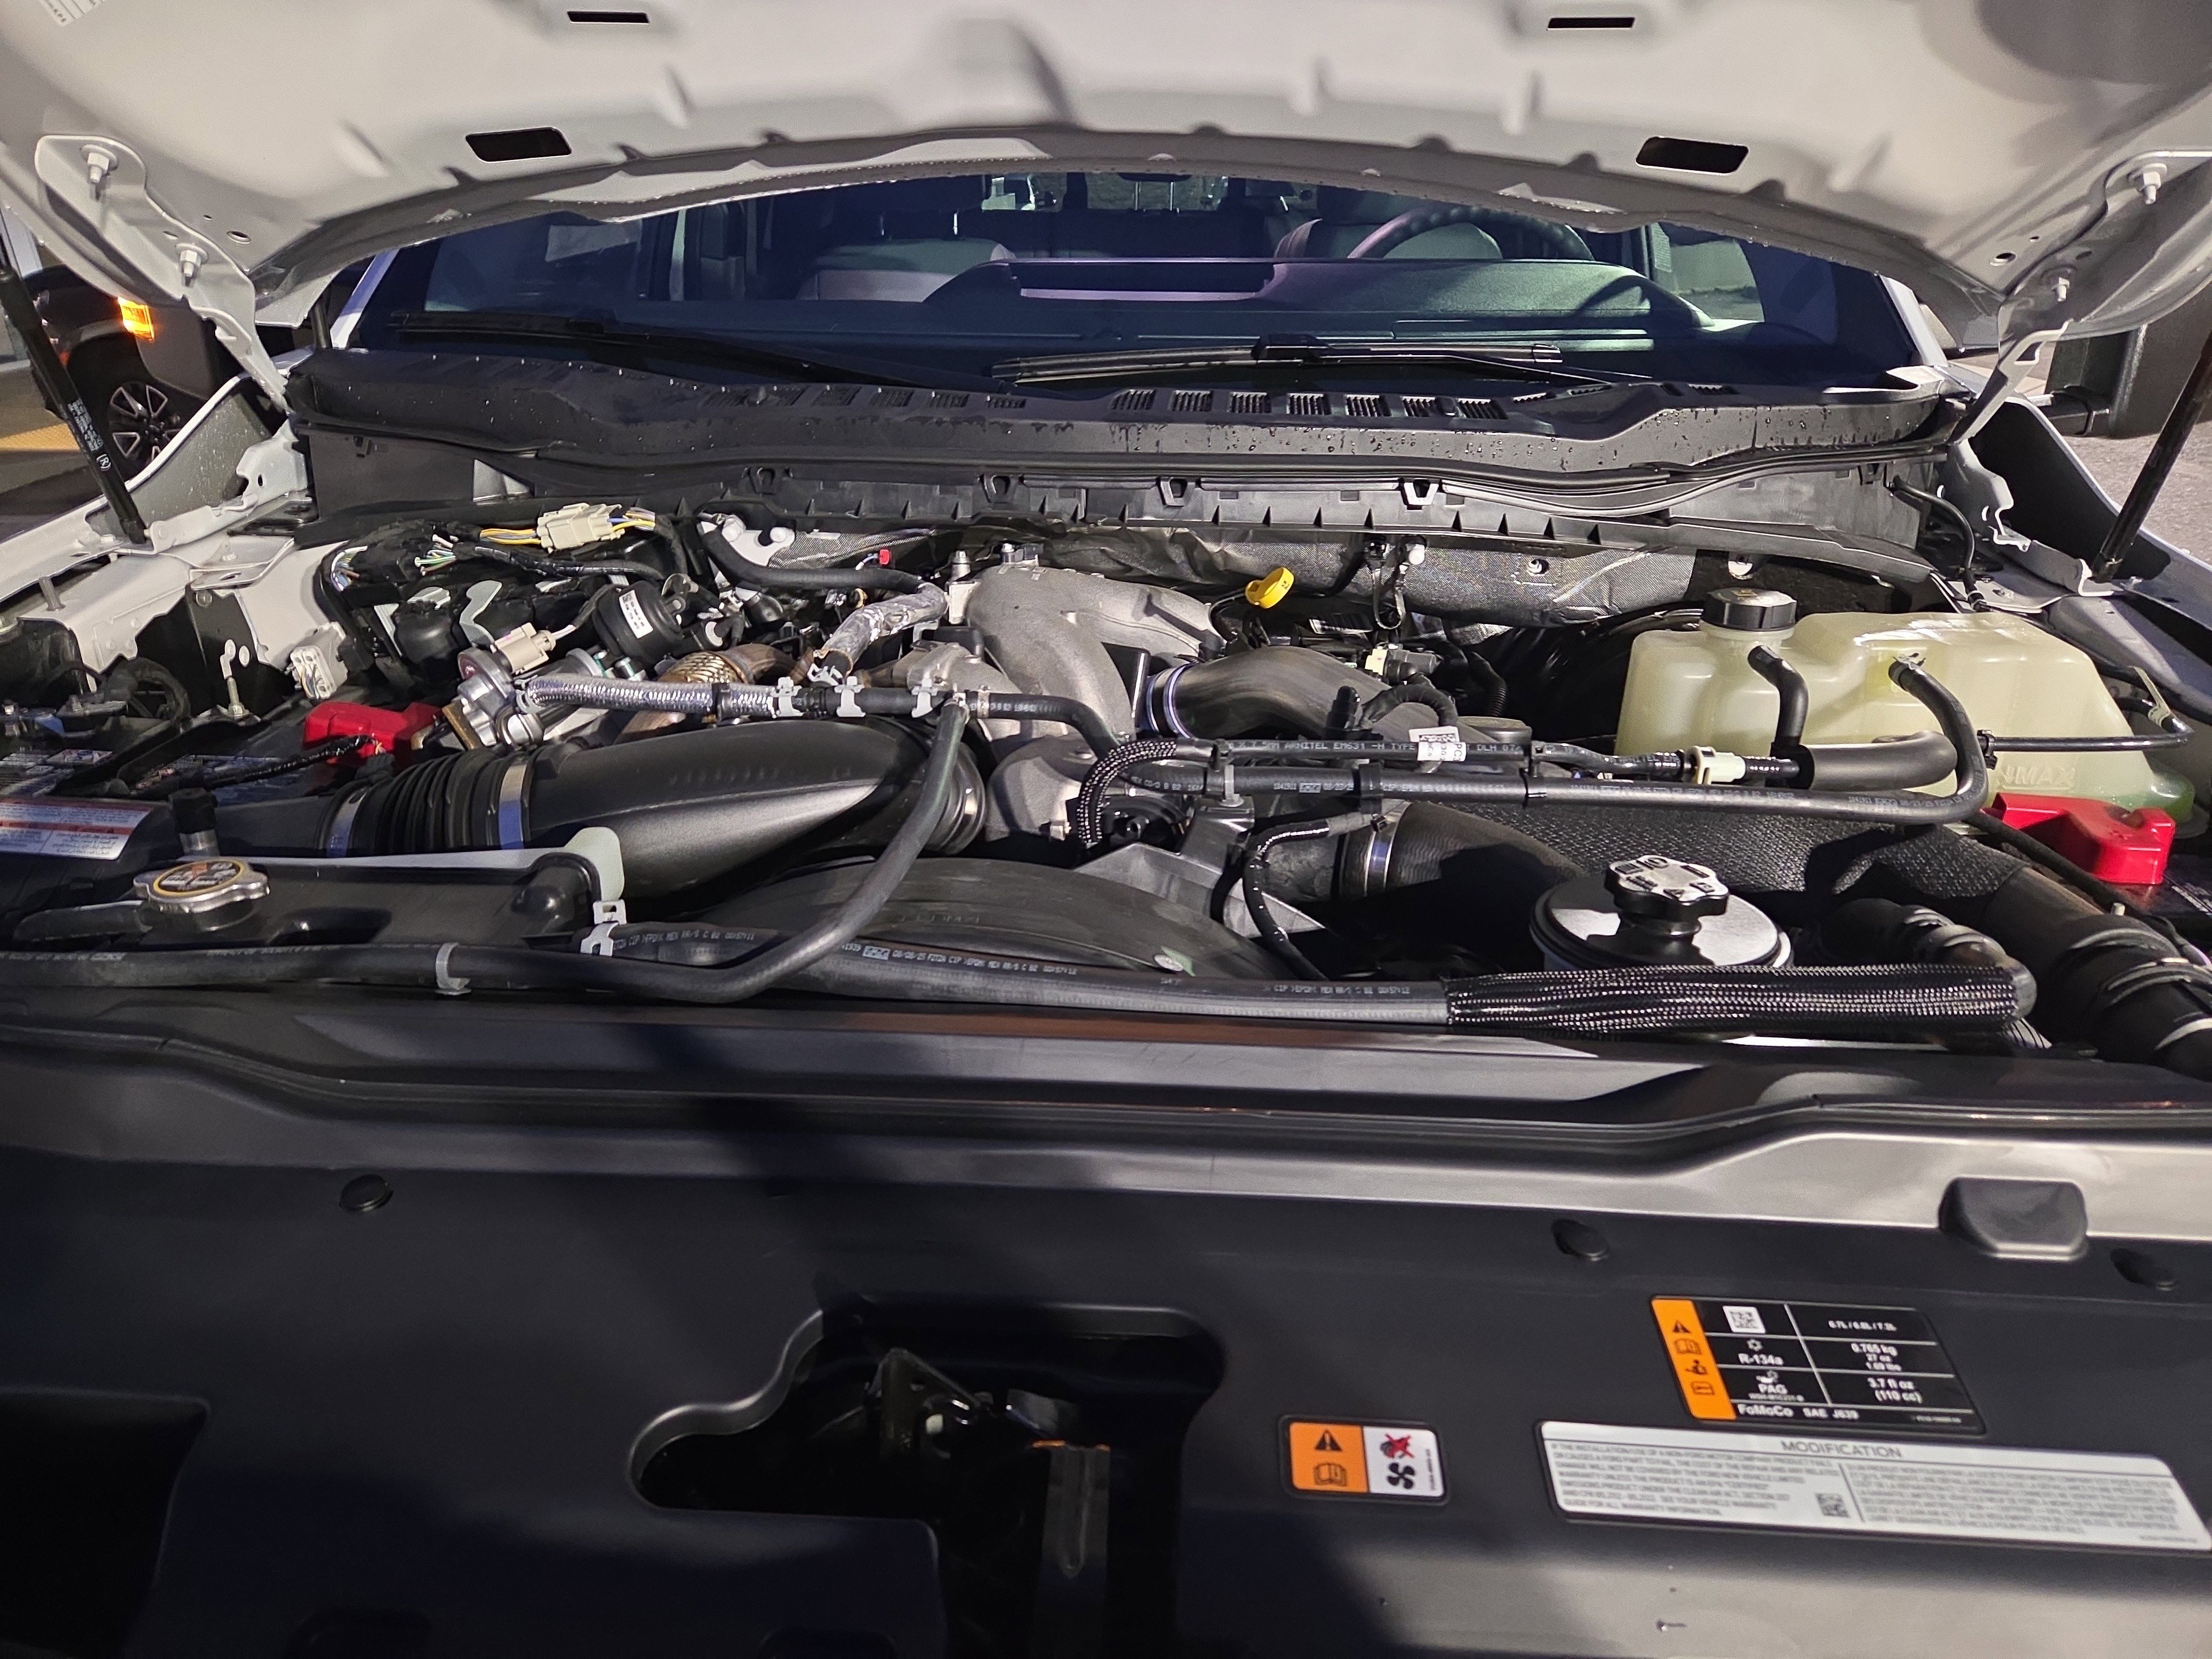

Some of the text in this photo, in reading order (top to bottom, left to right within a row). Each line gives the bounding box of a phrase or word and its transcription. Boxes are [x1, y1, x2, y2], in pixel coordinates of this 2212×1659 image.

[1738, 1353, 1784, 1366] R-134a
[1758, 1384, 1787, 1395] PAG
[1867, 1377, 1886, 1388] 3.7
[1899, 1380, 1914, 1390] oz
[1874, 1389, 1901, 1402] (110
[1737, 1404, 1794, 1418] FoMoCo
[1802, 1407, 1828, 1418] SAE
[1781, 1440, 1902, 1459] MODIFICATION
